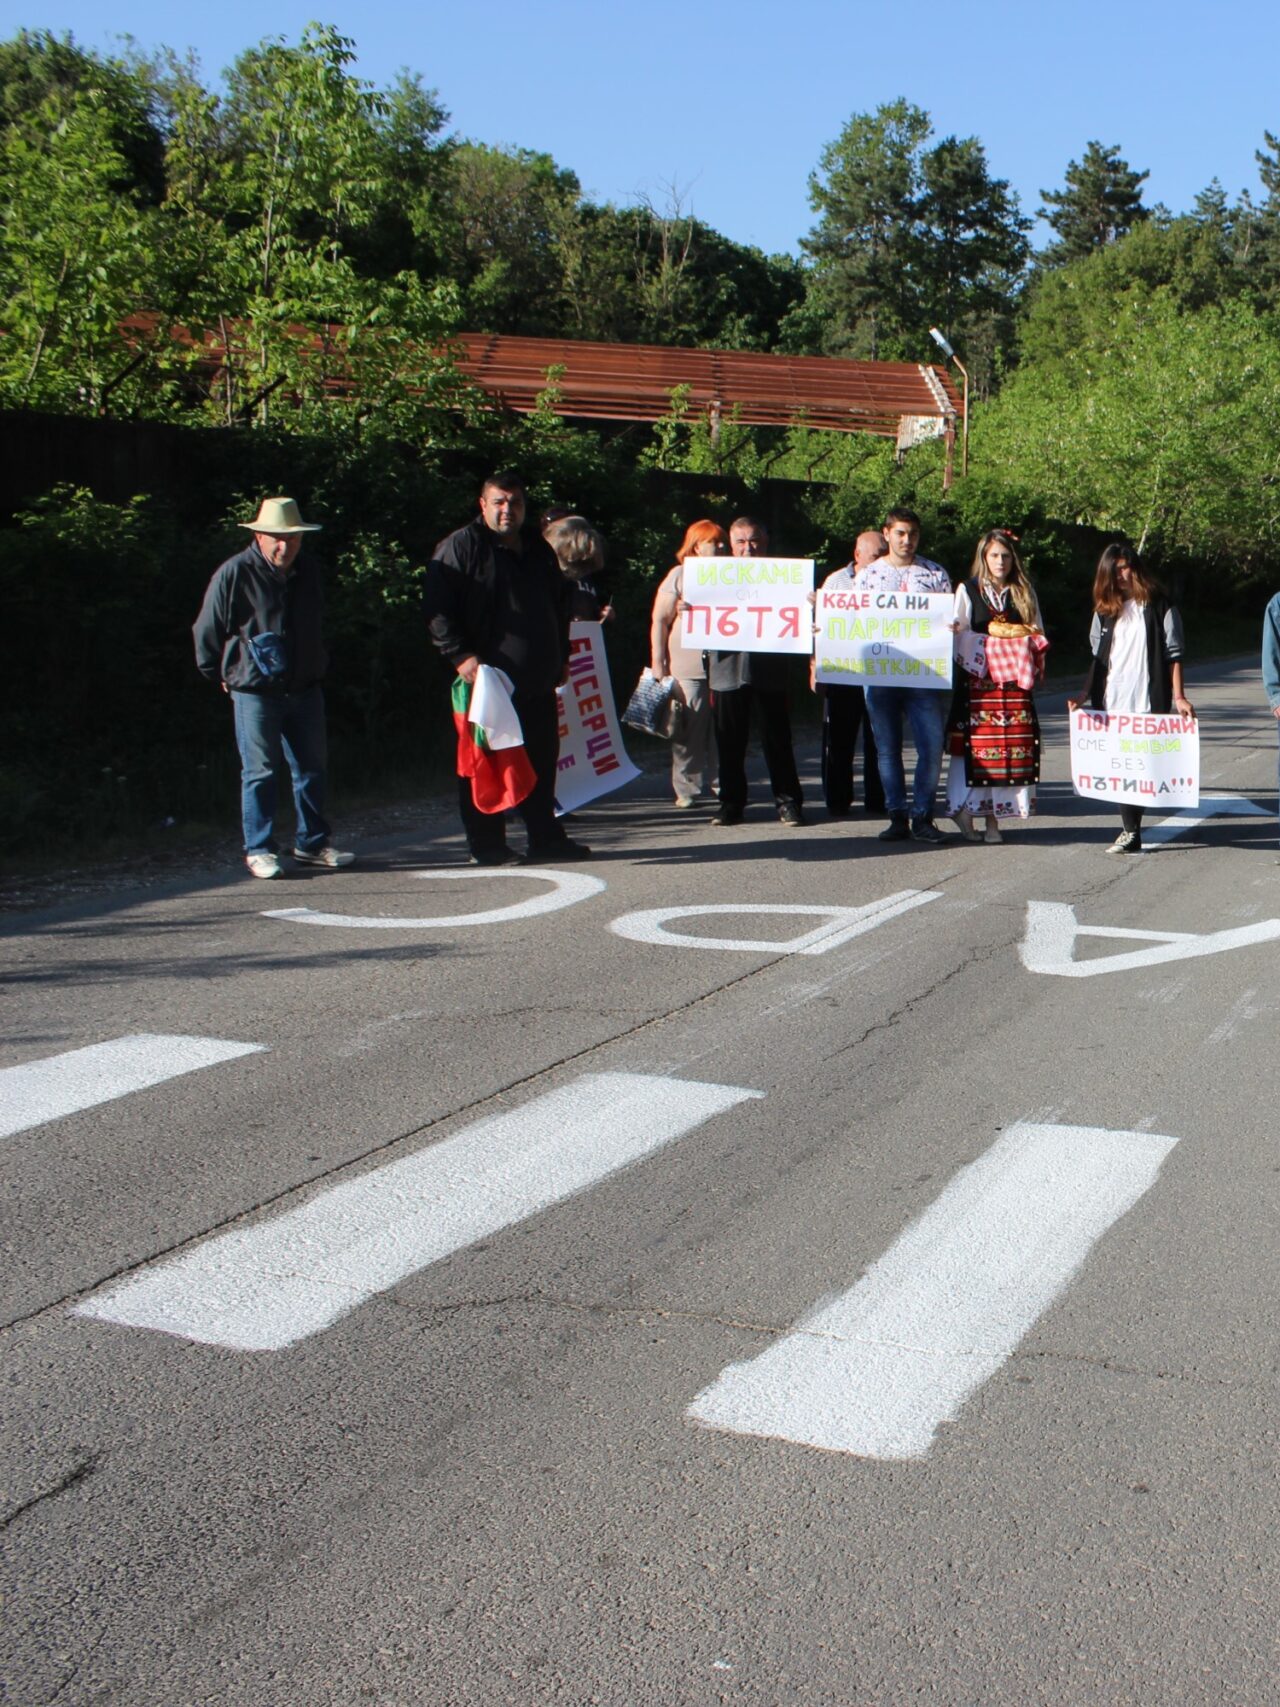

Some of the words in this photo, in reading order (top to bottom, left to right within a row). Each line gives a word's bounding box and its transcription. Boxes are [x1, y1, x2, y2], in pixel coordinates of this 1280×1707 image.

[697, 563, 804, 586] ИСКАМЕ
[823, 593, 870, 611] КЪДЕ
[876, 594, 898, 609] СА
[905, 596, 929, 610] НИ
[685, 605, 801, 638] ПЪТЯ
[827, 617, 932, 641] ПАРИТЕ
[871, 641, 894, 655] ОТ
[822, 657, 948, 677] ВИНЕТКИТЕ
[1078, 713, 1196, 735] ПОГРЕБАНИ
[1077, 738, 1107, 752] СМЕ
[1120, 738, 1182, 754] ЖИВИ
[1111, 757, 1146, 771] БЕЗ
